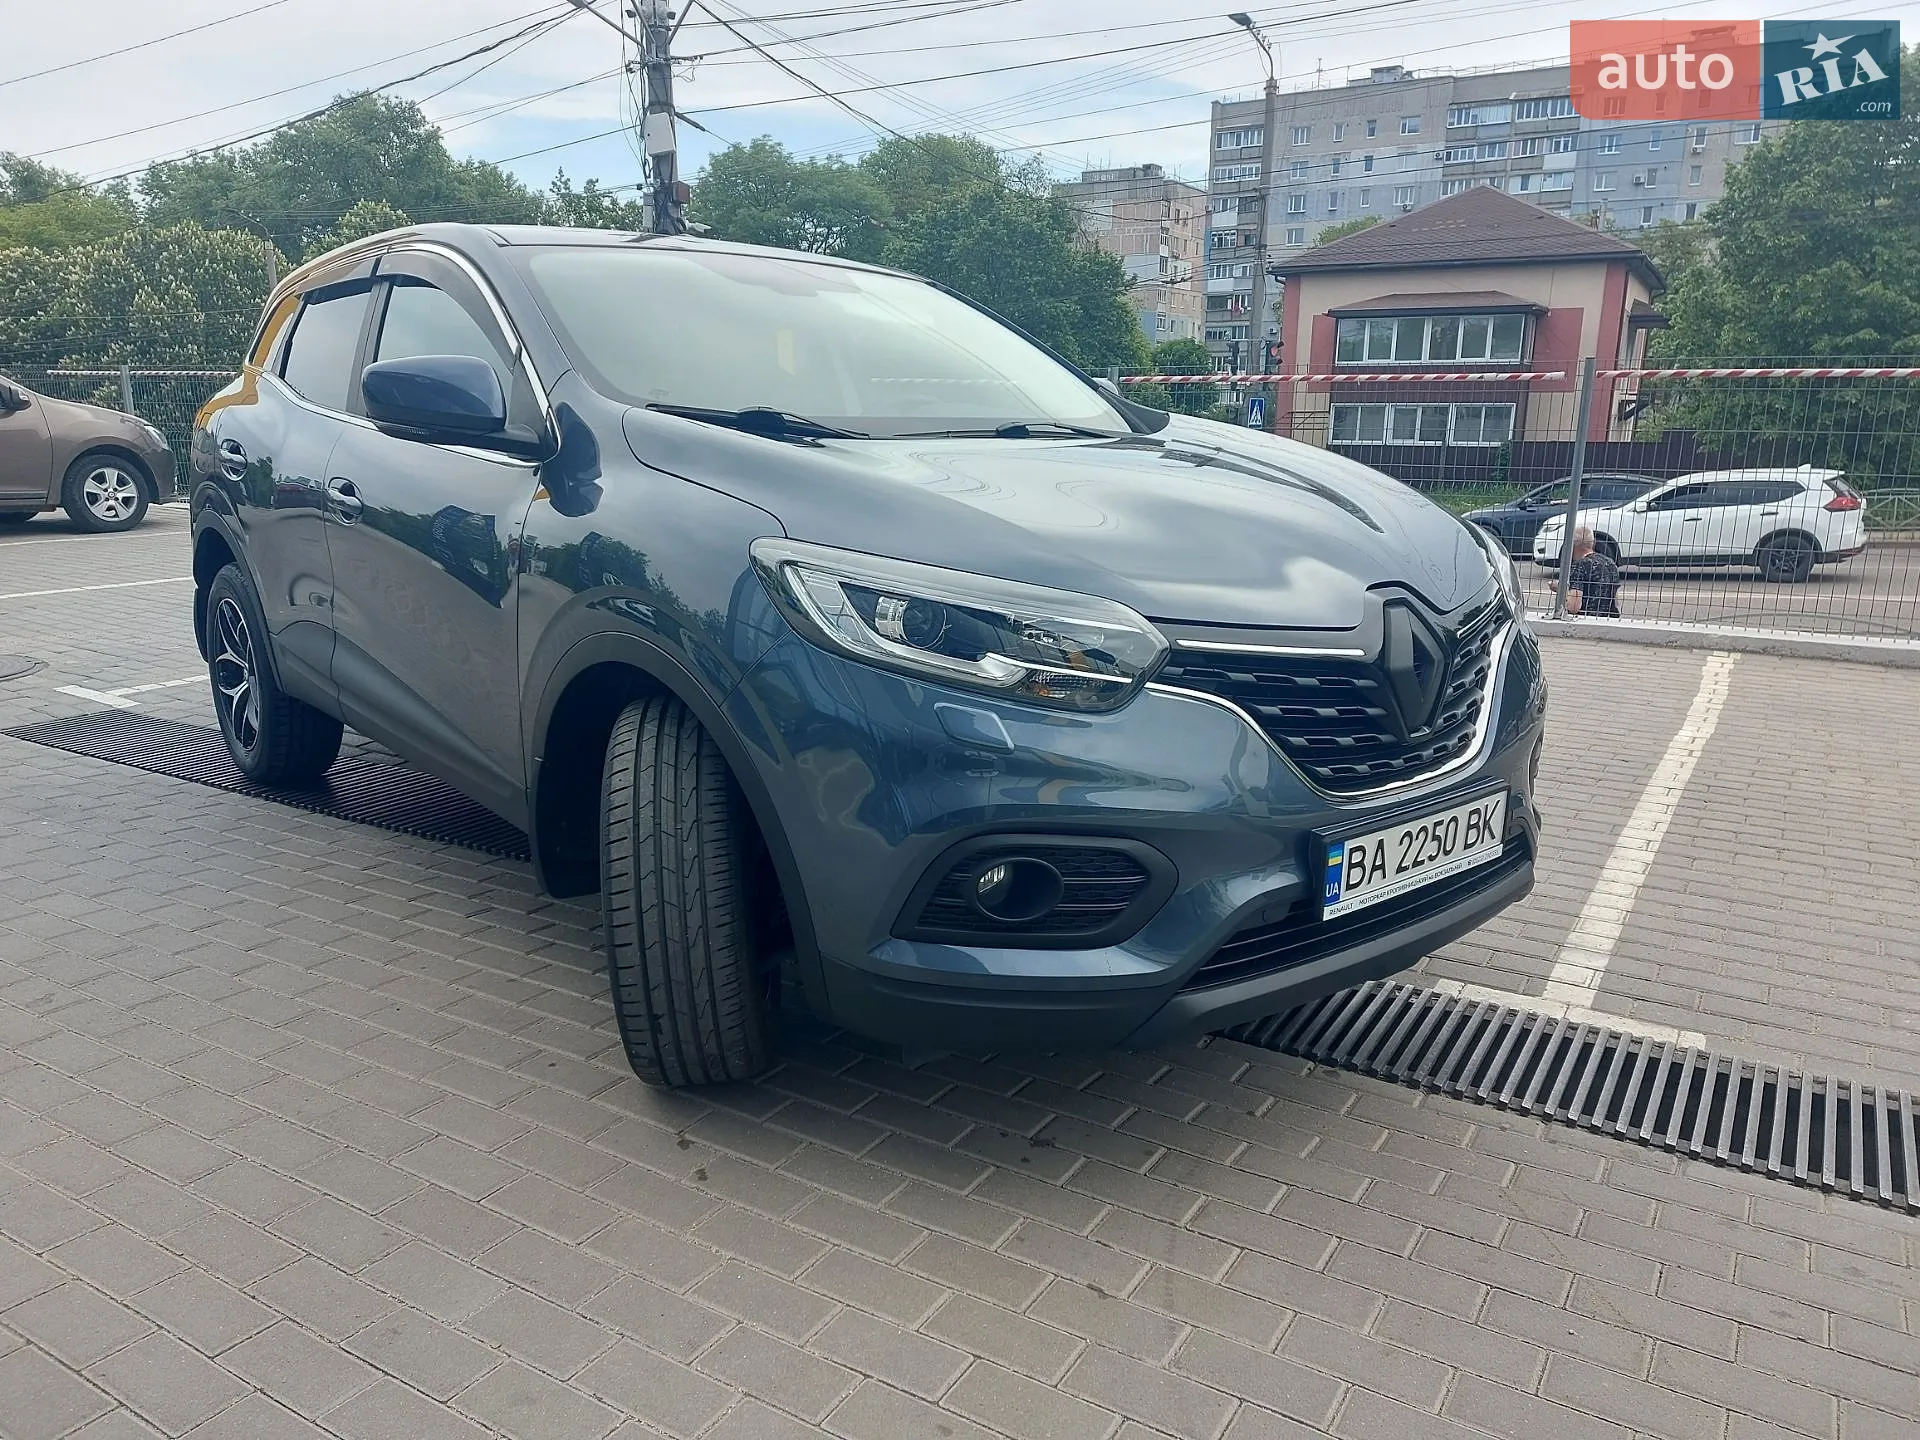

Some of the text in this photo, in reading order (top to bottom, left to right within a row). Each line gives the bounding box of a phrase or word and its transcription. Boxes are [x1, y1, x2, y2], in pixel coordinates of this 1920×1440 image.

[1345, 799, 1501, 892] BA 2250 BK
[1326, 881, 1339, 898] UA
[1329, 903, 1354, 915] RENAULT
